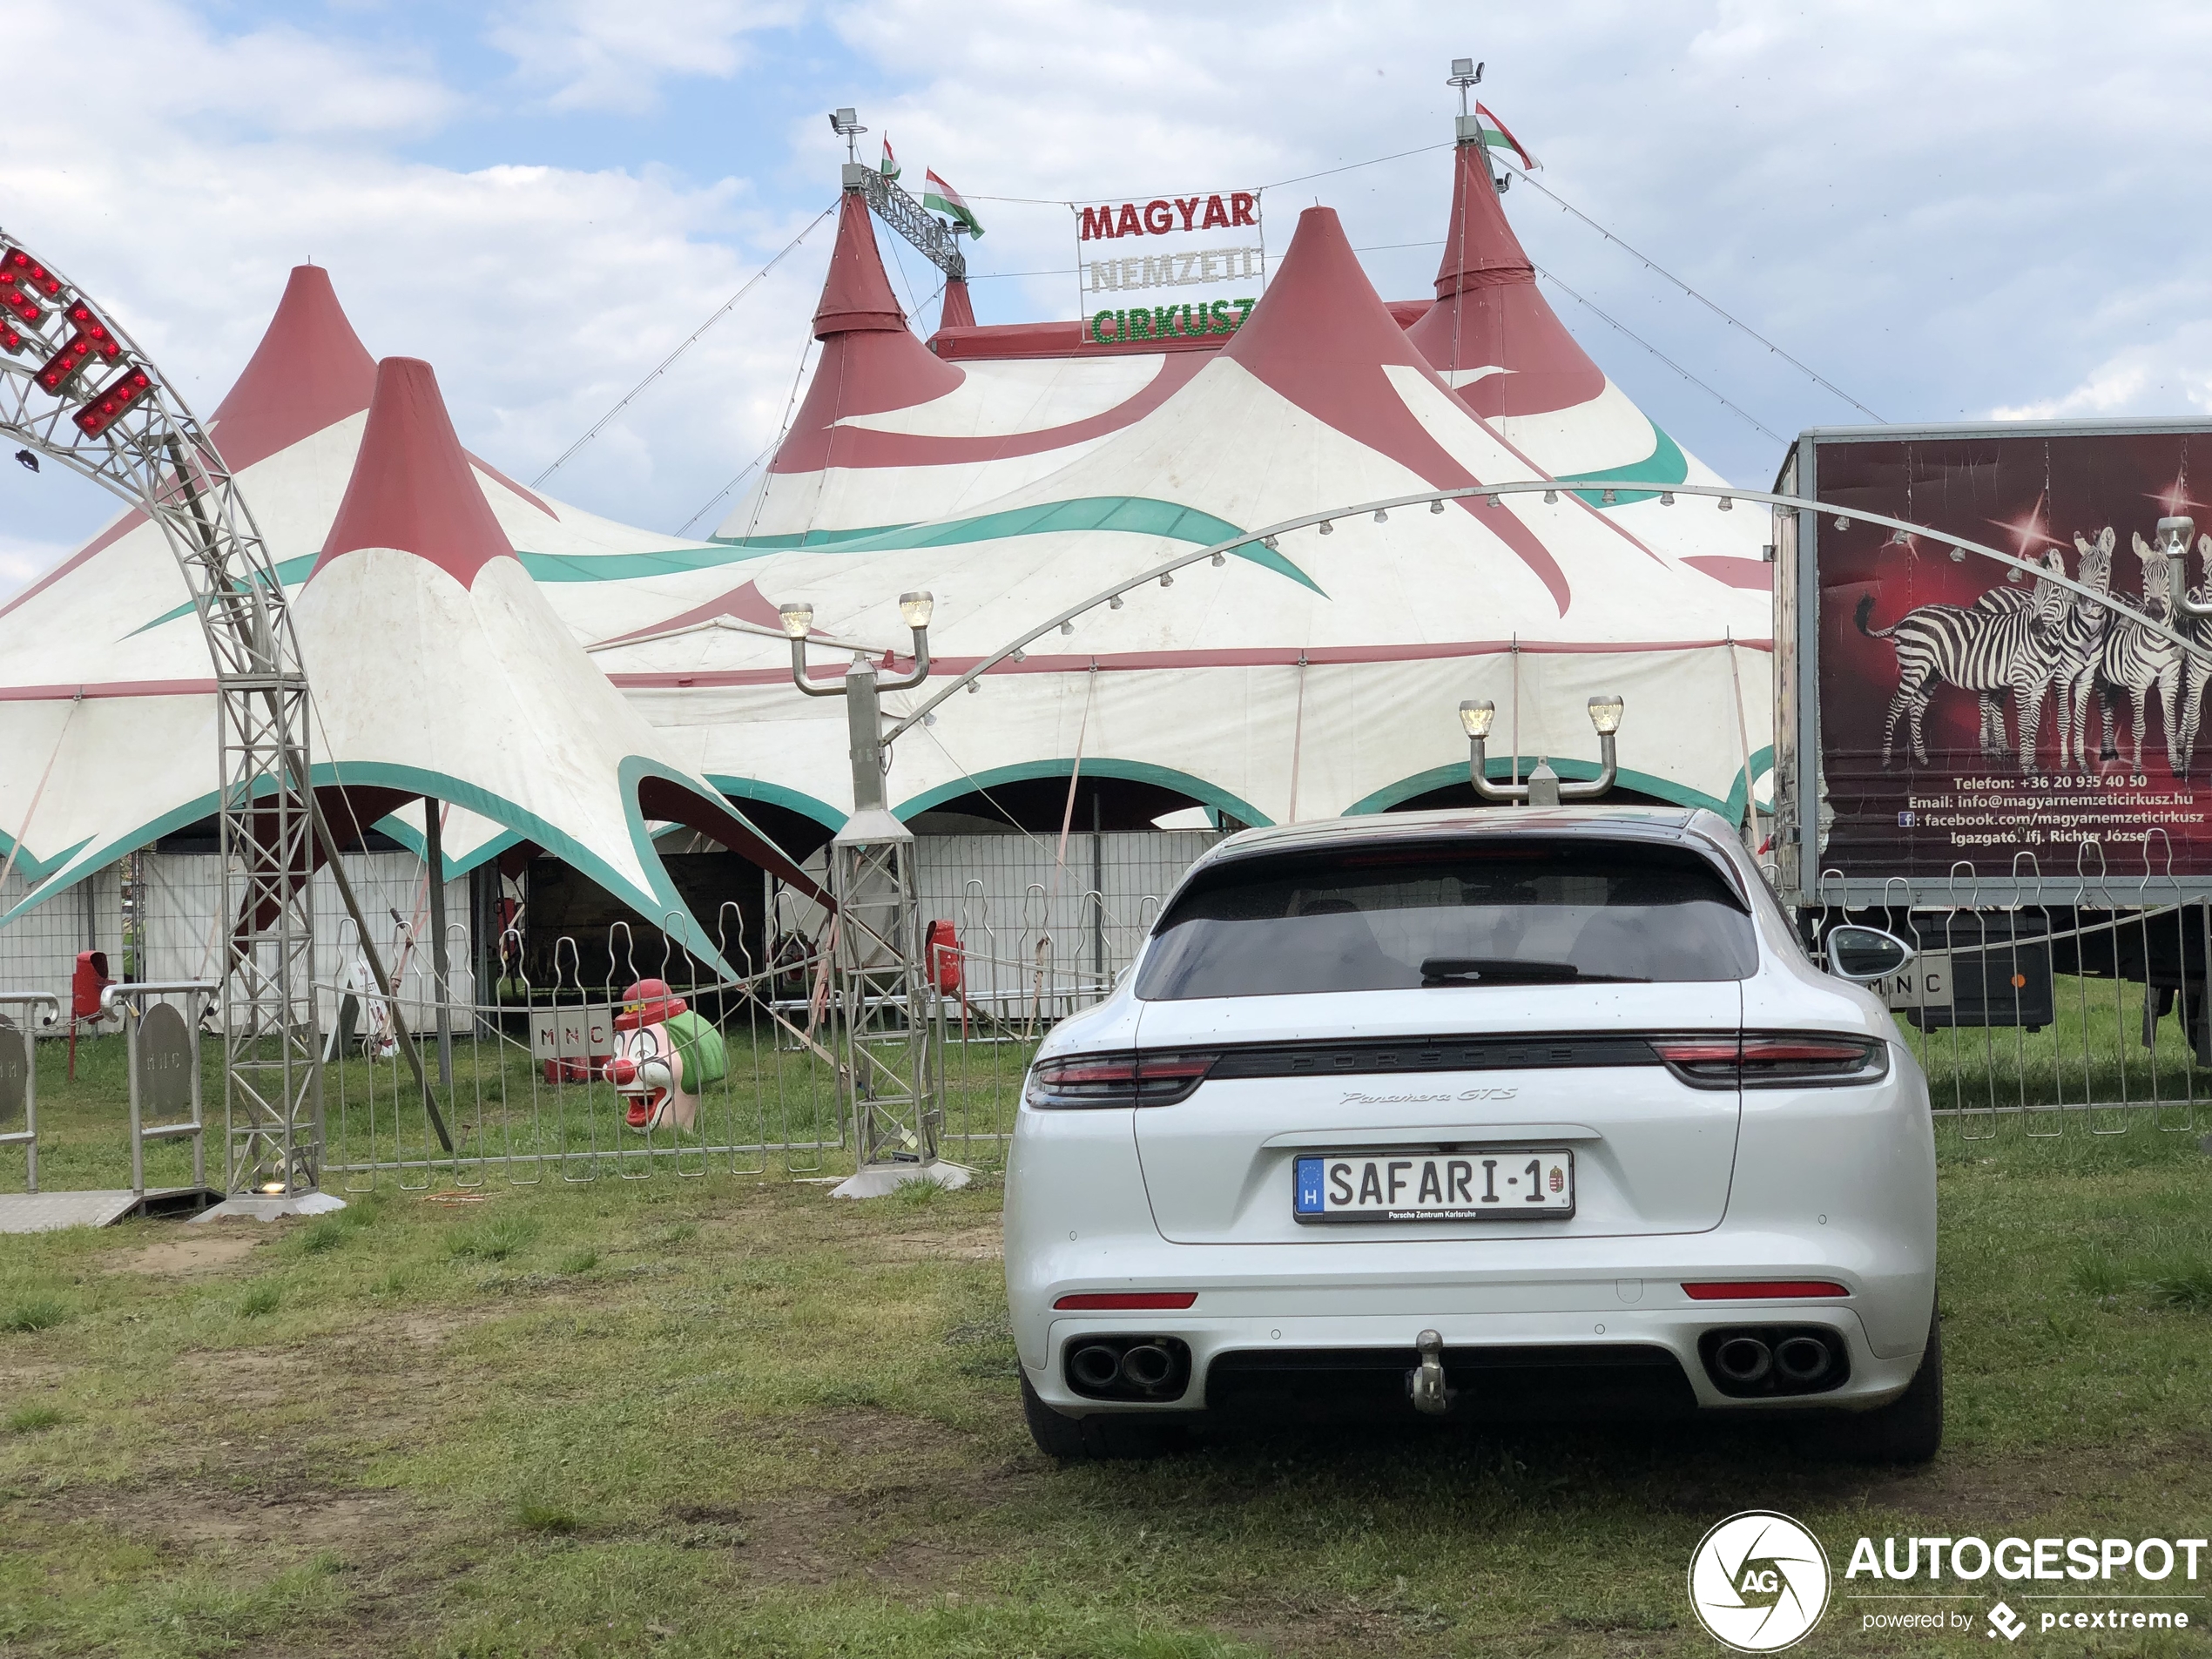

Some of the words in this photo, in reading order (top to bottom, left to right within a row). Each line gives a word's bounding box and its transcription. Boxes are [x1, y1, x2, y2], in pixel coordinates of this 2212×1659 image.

[1082, 192, 1257, 241] MAGYAR
[1090, 246, 1252, 293] NEMZETI
[1091, 297, 1256, 345] CIRKUSZ
[1953, 777, 2015, 789] Telefon:
[2020, 776, 2049, 788] +36
[2054, 775, 2073, 788] 20
[2075, 775, 2101, 788] 935
[2105, 775, 2125, 787] 40
[2129, 774, 2148, 787] 50
[1909, 795, 1953, 809] Email:
[1958, 792, 2193, 809] info@magyarnemzeticirkusz.hu
[1925, 811, 2204, 827] facebook.com/magyarnemzeticirkusz
[2050, 830, 2101, 842] Richter
[1291, 1048, 1573, 1070] PORSCHE
[1339, 1090, 1452, 1105] Panamera
[1456, 1087, 1519, 1102] GTS
[1304, 1190, 1317, 1205] H
[1329, 1159, 1546, 1206] SAFARI-1
[1445, 1210, 1476, 1218] Karlsruhe
